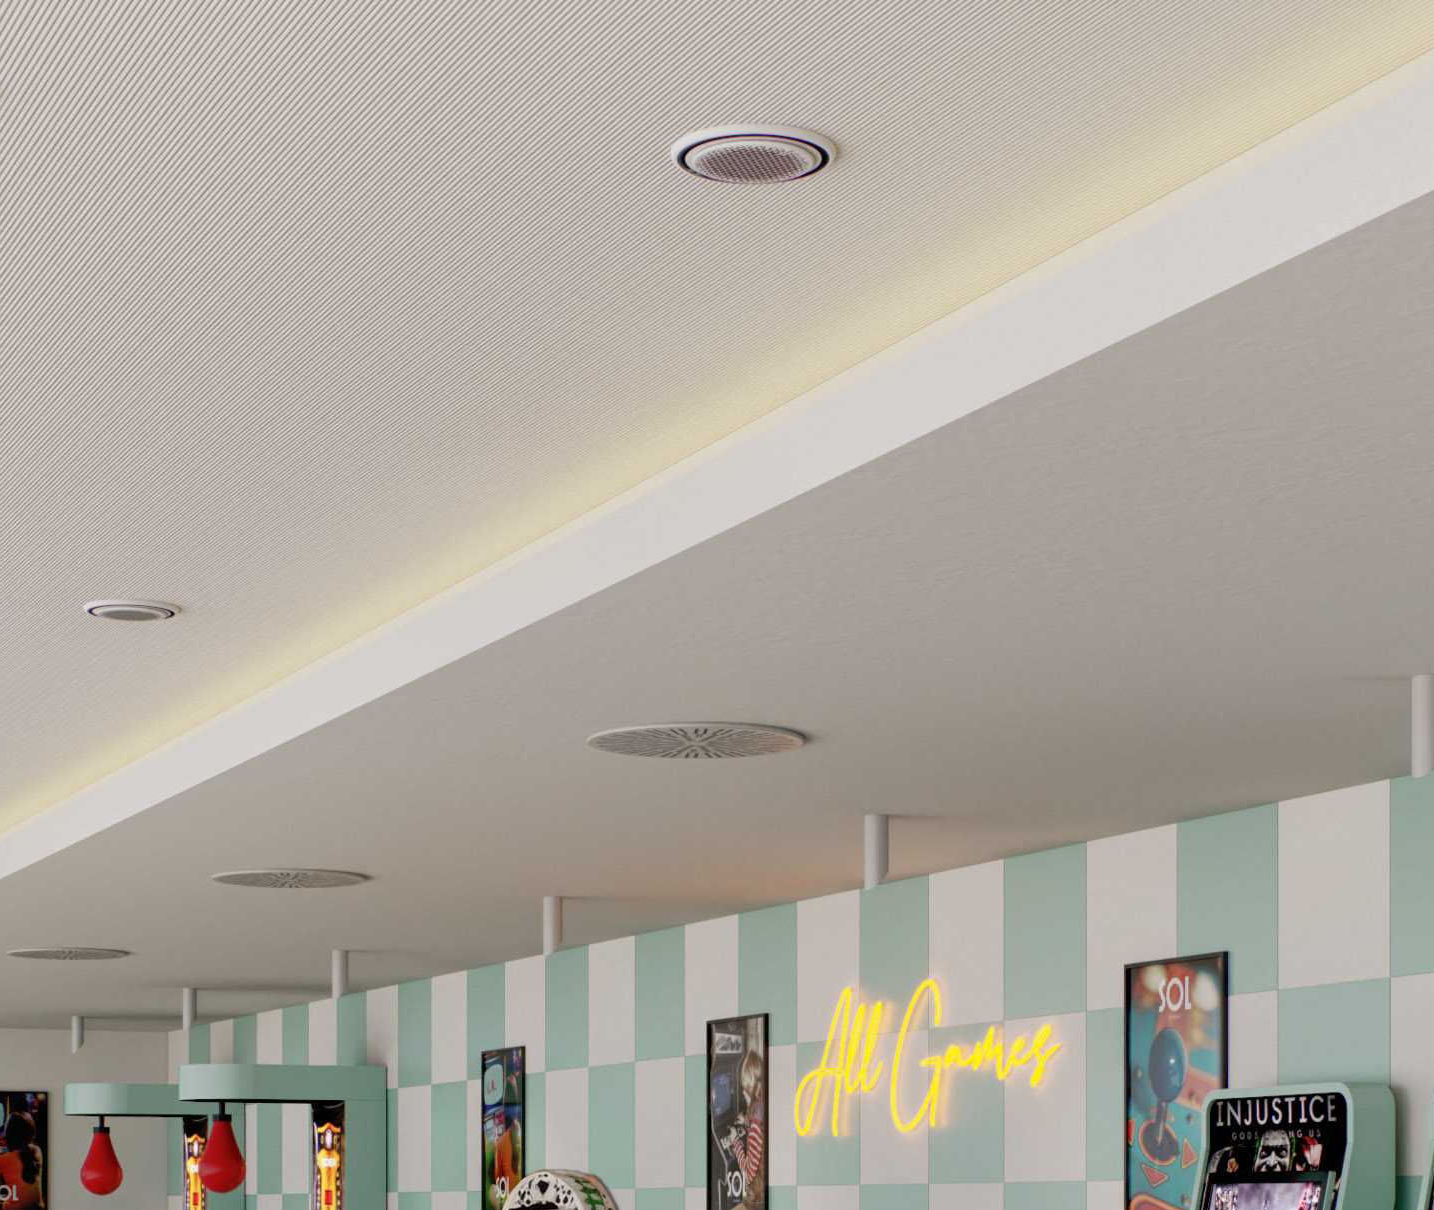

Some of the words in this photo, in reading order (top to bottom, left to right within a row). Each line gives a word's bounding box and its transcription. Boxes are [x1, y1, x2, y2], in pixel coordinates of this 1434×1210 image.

[1158, 975, 1192, 1013] SOL
[795, 987, 883, 1136] All
[891, 979, 1064, 1132] Games
[1216, 1095, 1338, 1127] INJUSTICE
[1231, 1131, 1259, 1141] GODS
[1264, 1129, 1303, 1141] AMONG
[1308, 1128, 1322, 1138] US
[496, 1176, 510, 1199] SOL
[727, 1170, 747, 1198] SOL
